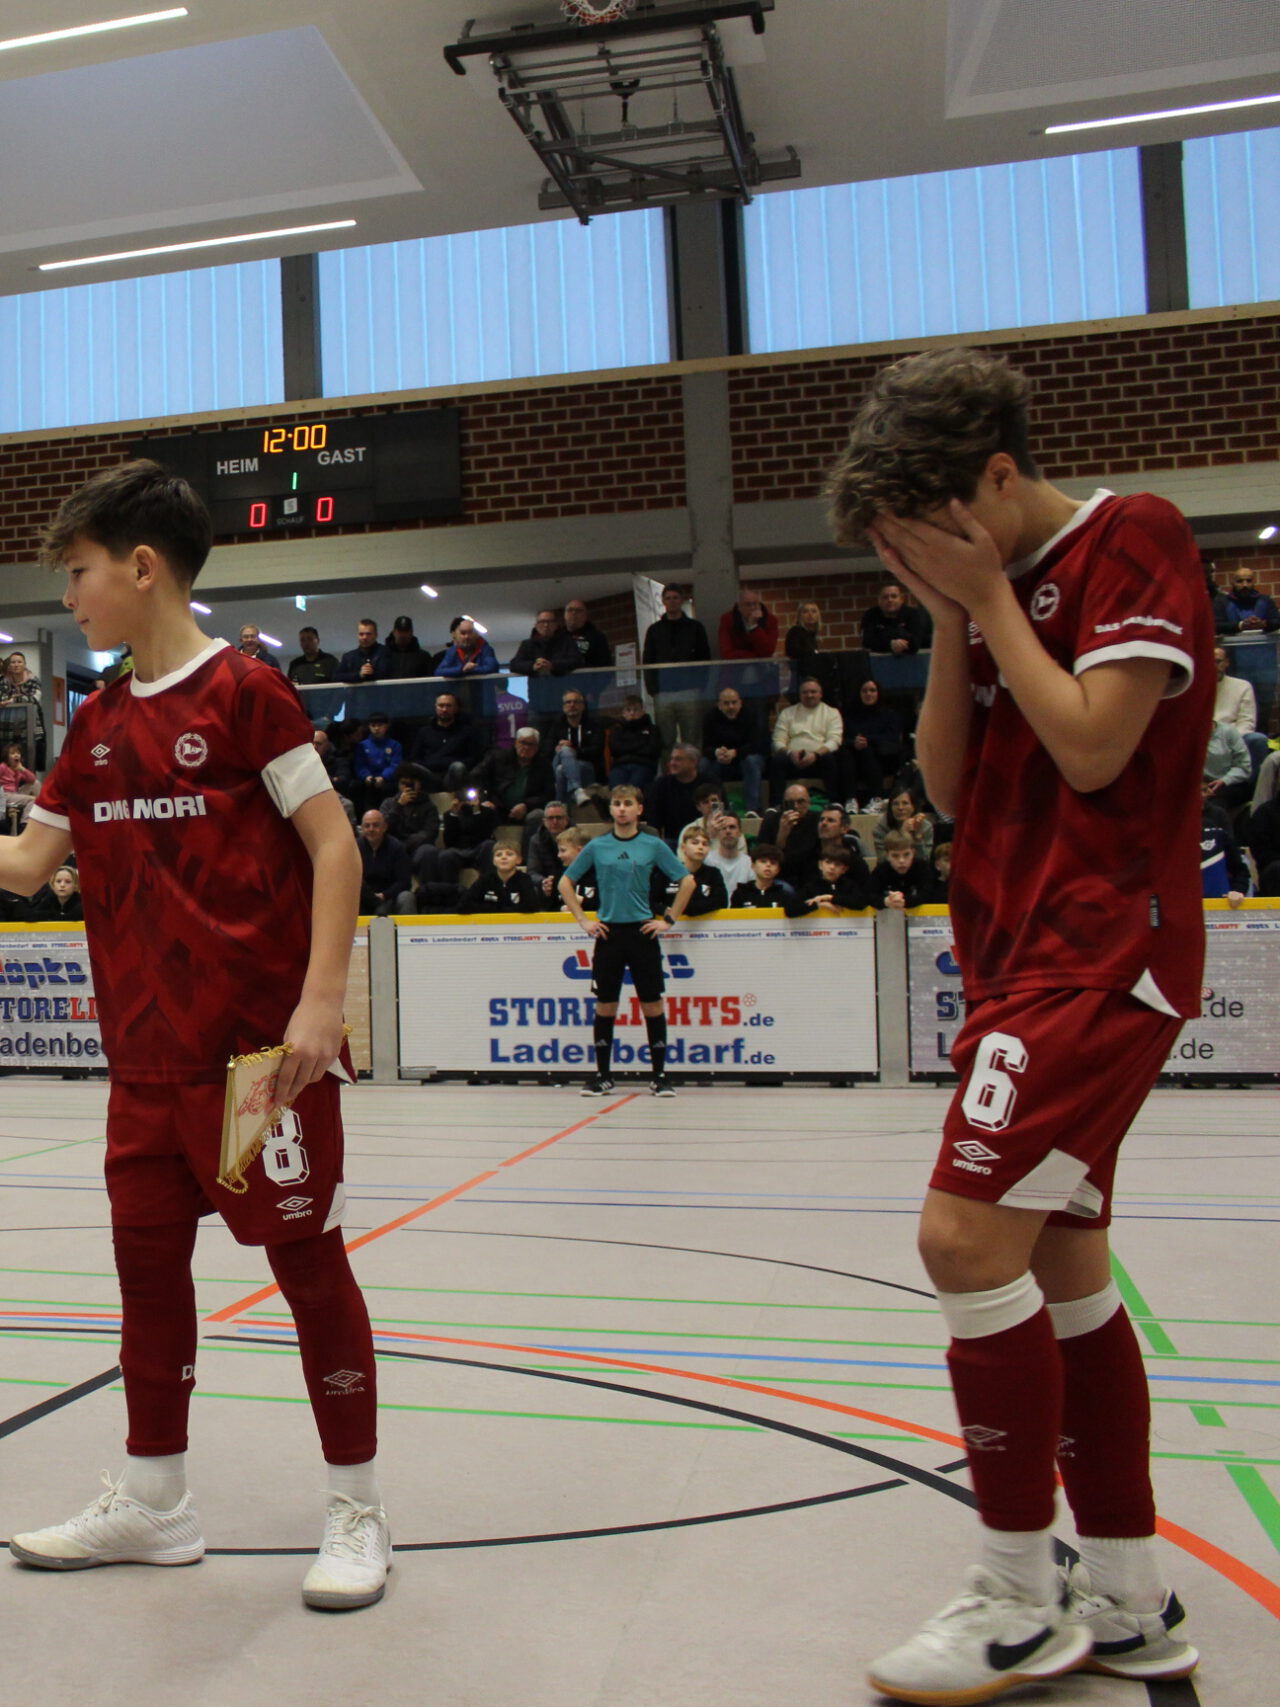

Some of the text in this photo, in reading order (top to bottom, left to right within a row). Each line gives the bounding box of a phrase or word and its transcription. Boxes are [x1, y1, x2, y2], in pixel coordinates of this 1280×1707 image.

[216, 447, 367, 475] HEIM GAST
[291, 471, 298, 490] 1
[249, 496, 335, 528] 0 0
[508, 713, 516, 738] 1
[961, 1031, 1029, 1132] 6
[262, 1108, 310, 1187] 8
[952, 1158, 992, 1176] umbro
[282, 1209, 313, 1221] umbro
